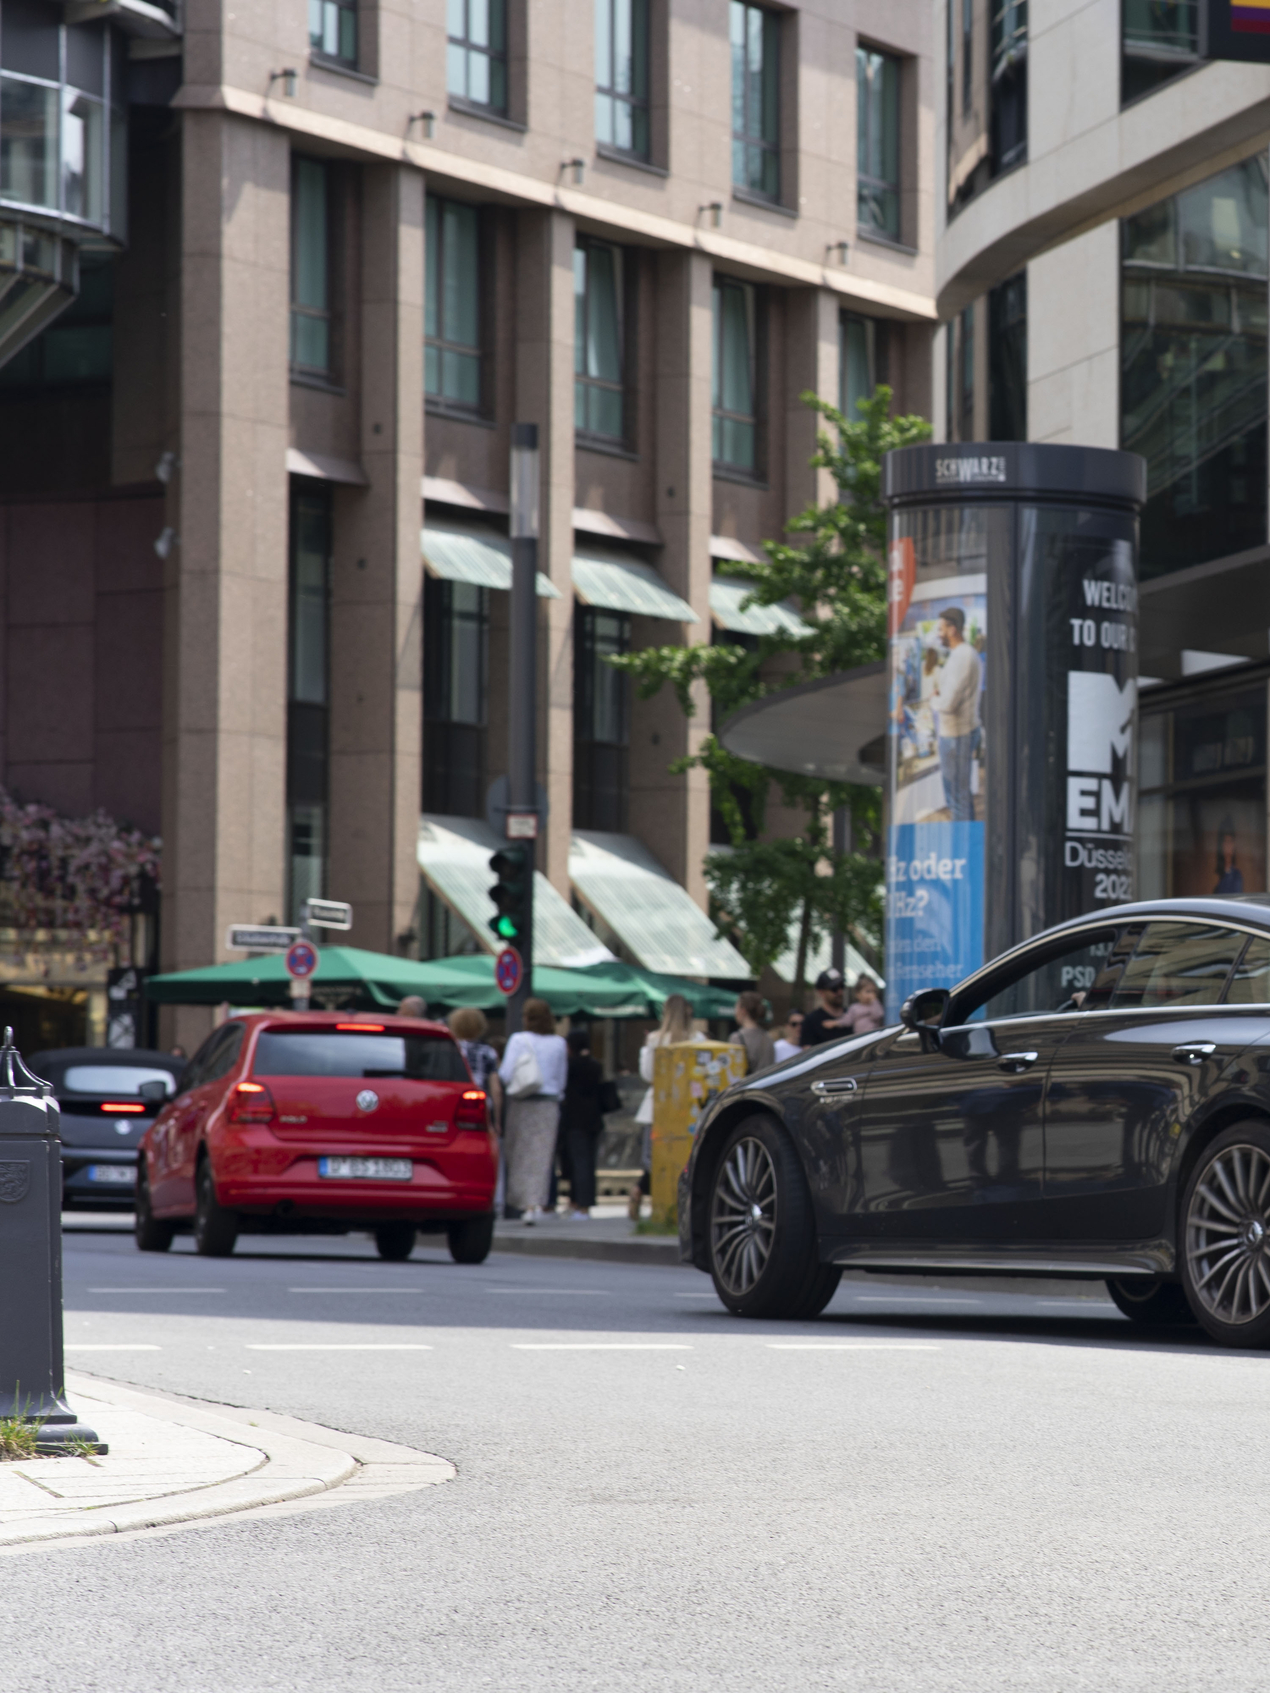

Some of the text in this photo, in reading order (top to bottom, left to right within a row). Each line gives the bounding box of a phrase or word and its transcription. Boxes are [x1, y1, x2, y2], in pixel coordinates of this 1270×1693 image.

[935, 456, 999, 482] SCHWARZ
[1070, 618, 1096, 647] TO
[1100, 621, 1128, 651] OUR
[910, 852, 966, 881] oder
[1061, 966, 1096, 988] PSD
